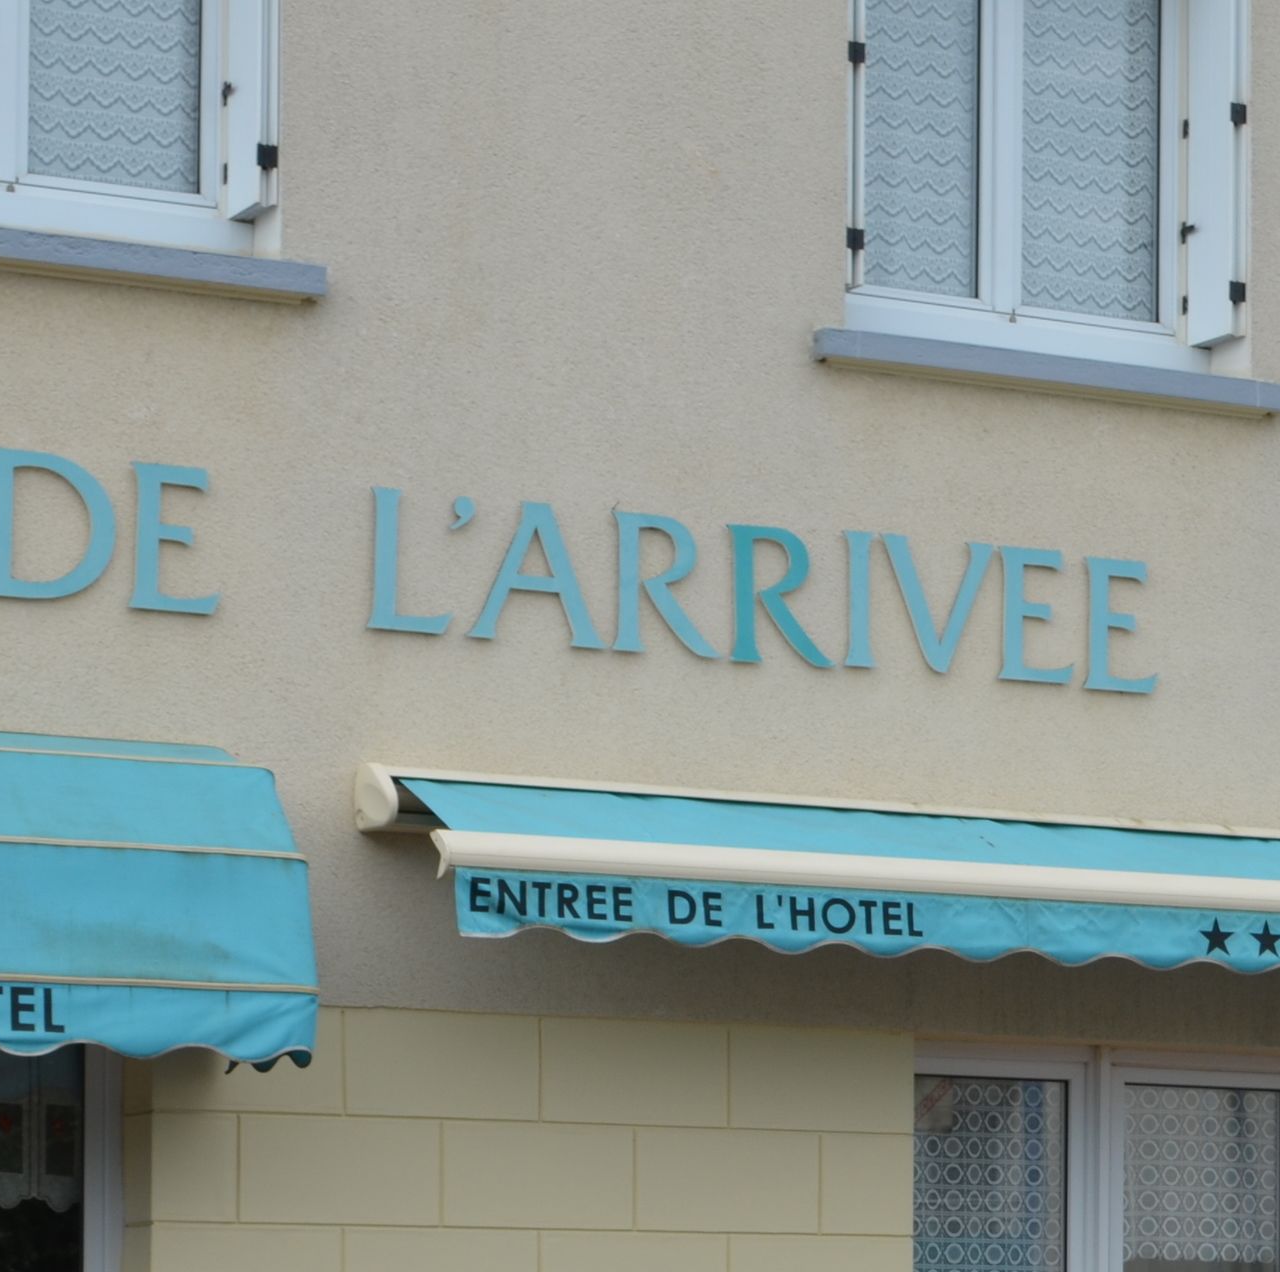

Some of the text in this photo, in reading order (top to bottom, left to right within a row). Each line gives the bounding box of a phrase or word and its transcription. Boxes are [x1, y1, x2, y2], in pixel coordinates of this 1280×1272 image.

[365, 485, 1159, 694] L'ARRIVEE
[469, 877, 923, 937] ENTREE DE L'HOTEL
